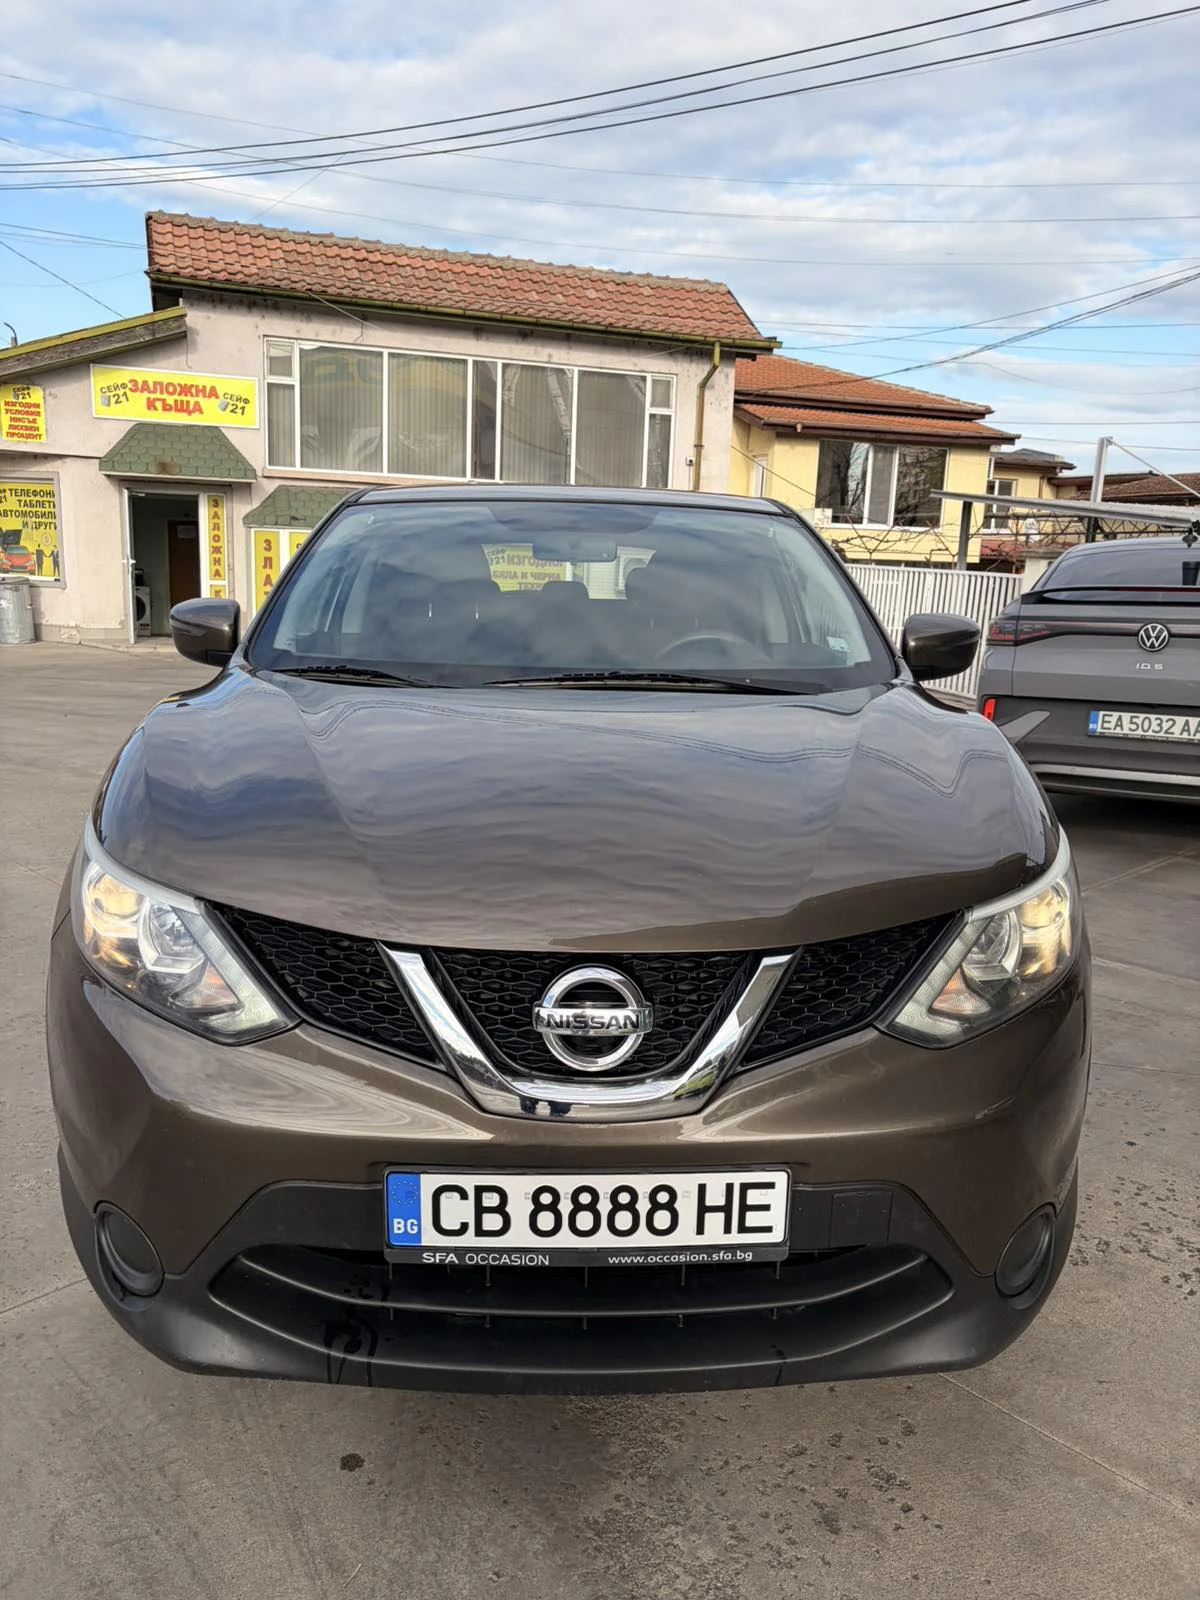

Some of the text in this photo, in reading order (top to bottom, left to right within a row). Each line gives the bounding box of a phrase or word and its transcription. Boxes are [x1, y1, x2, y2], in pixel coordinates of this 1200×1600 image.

[100, 382, 128, 395] СЕЙФ
[128, 378, 220, 399] ЗАЛОЖНА
[112, 391, 130, 405] 21
[222, 392, 250, 405] СЕЙФ
[146, 397, 204, 416] КЪЩА
[229, 403, 246, 416] 21
[22, 520, 29, 529] И
[211, 498, 222, 578] ЗАЛОЖНА
[1101, 713, 1124, 731] EA
[1128, 716, 1176, 735] 5032
[546, 1013, 640, 1029] NISSAN
[431, 1182, 776, 1238] CB 8888 HE
[393, 1218, 418, 1234] BG
[422, 1252, 550, 1266] SFA OCCASION
[608, 1250, 753, 1265] www.occasion.sfa.bg
